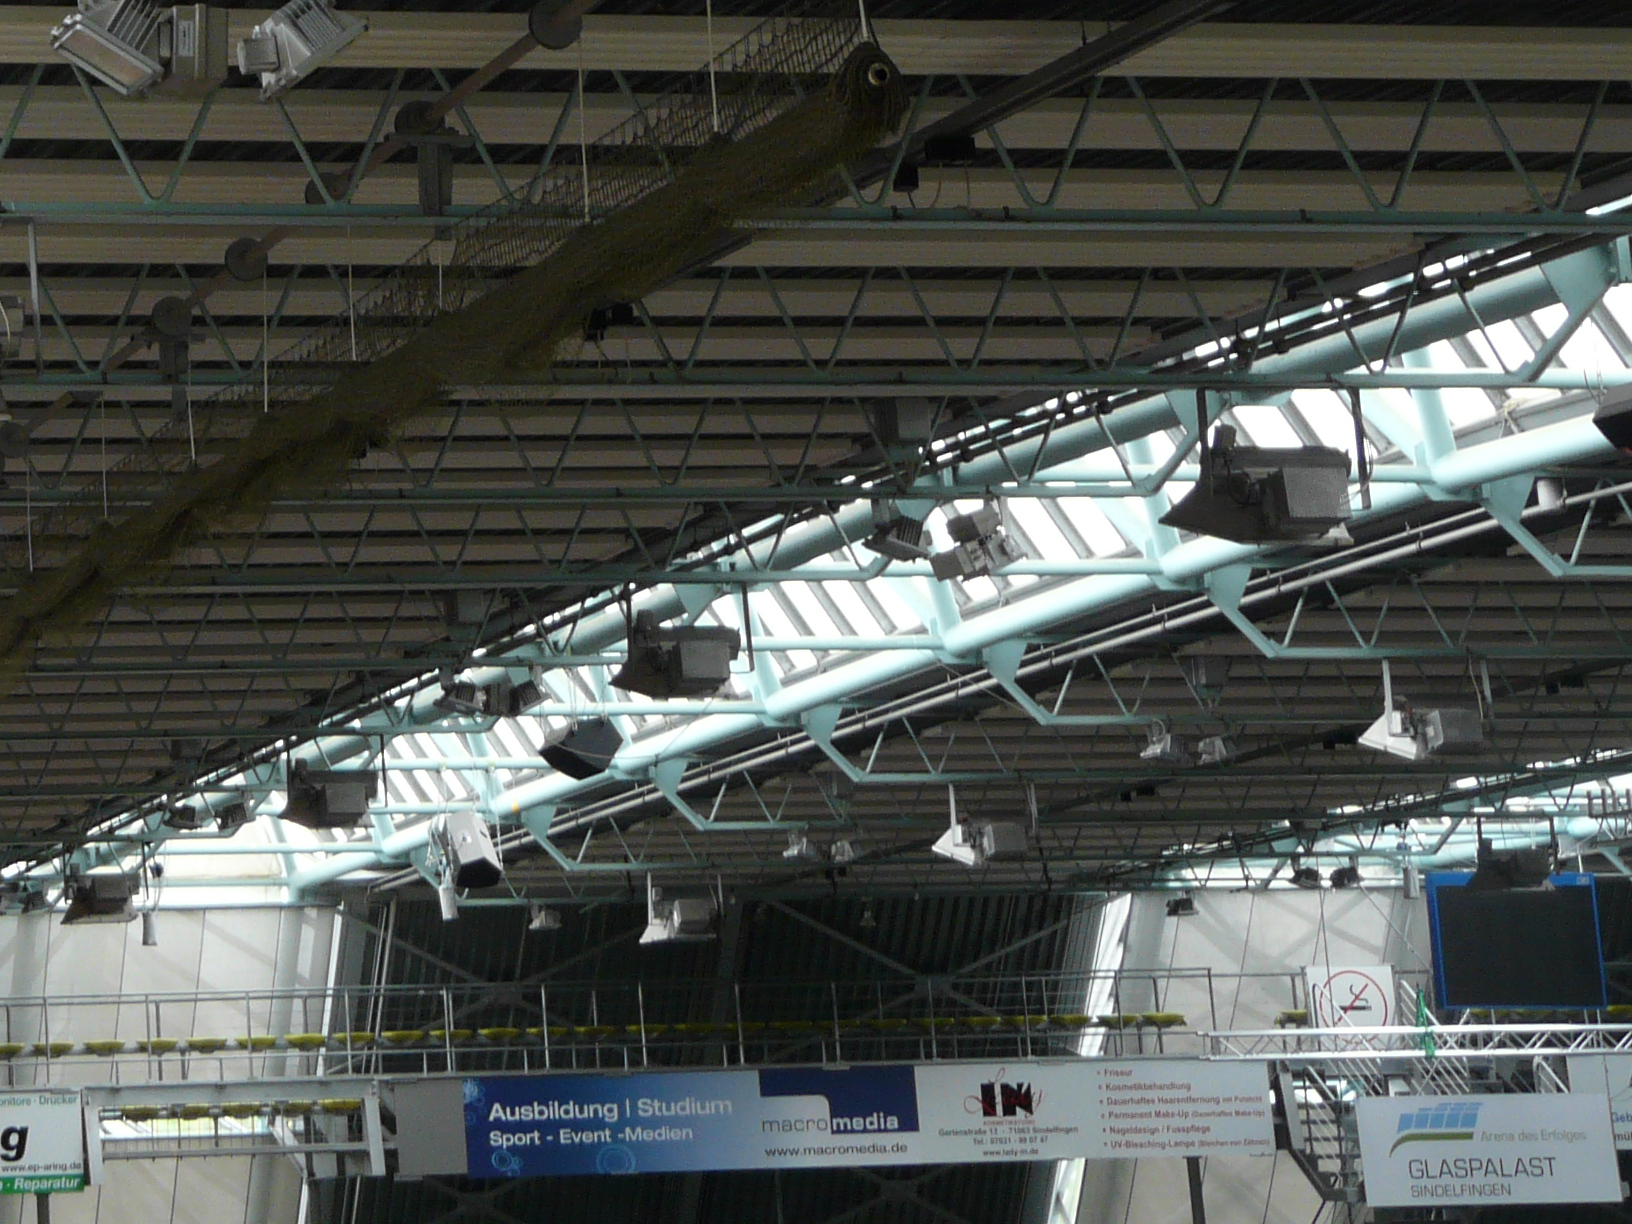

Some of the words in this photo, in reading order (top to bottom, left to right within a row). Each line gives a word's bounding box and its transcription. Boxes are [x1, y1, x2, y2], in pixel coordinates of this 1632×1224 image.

[1105, 1080, 1191, 1092] Kosmetikbehandlung
[39, 1094, 77, 1106] Drucker
[1157, 1094, 1220, 1106] Haarentfernung
[488, 1100, 618, 1122] Ausbildung
[637, 1097, 732, 1117] Studium
[1109, 1125, 1160, 1137] Nageldesign
[1167, 1123, 1211, 1135] Fusspflege
[1480, 1131, 1515, 1142] Arena
[1518, 1130, 1538, 1142] des
[1540, 1129, 1586, 1143] Erfolges
[489, 1129, 541, 1149] Sport
[560, 1127, 612, 1144] Event
[764, 1142, 908, 1156] www.macromedia.de
[1409, 1157, 1556, 1179] GLASPALAST
[14, 1177, 80, 1192] Reparatur
[1410, 1183, 1511, 1198] SINDELFINGEN
